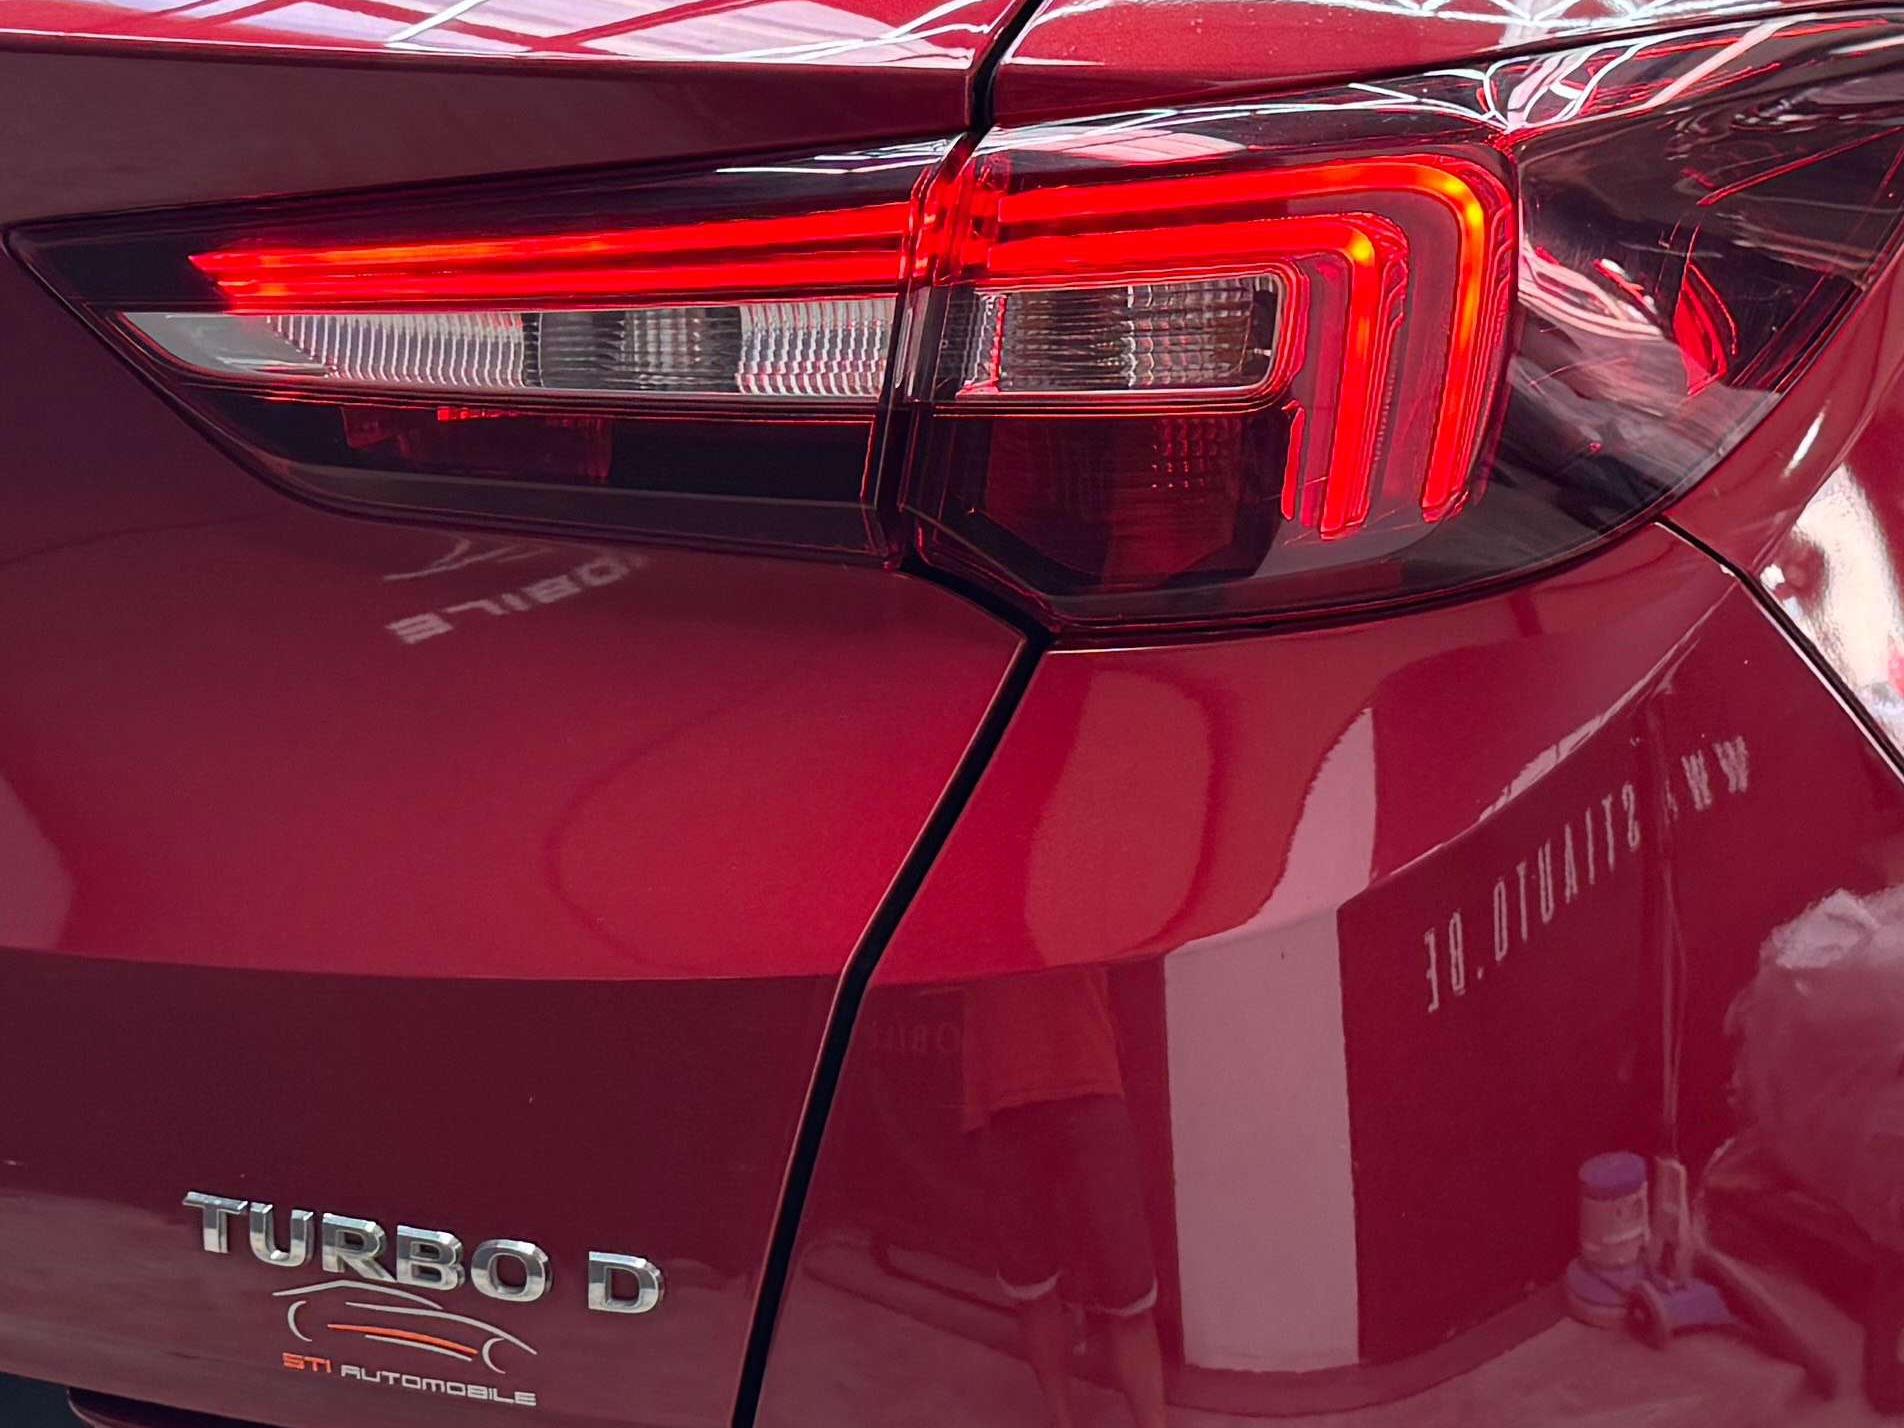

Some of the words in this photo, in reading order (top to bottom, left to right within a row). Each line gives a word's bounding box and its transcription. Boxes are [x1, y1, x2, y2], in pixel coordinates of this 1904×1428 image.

[182, 1190, 552, 1303] TURBO
[587, 1250, 666, 1314] D
[281, 1352, 332, 1374] STI
[340, 1365, 537, 1406] AUTOMOBILE
